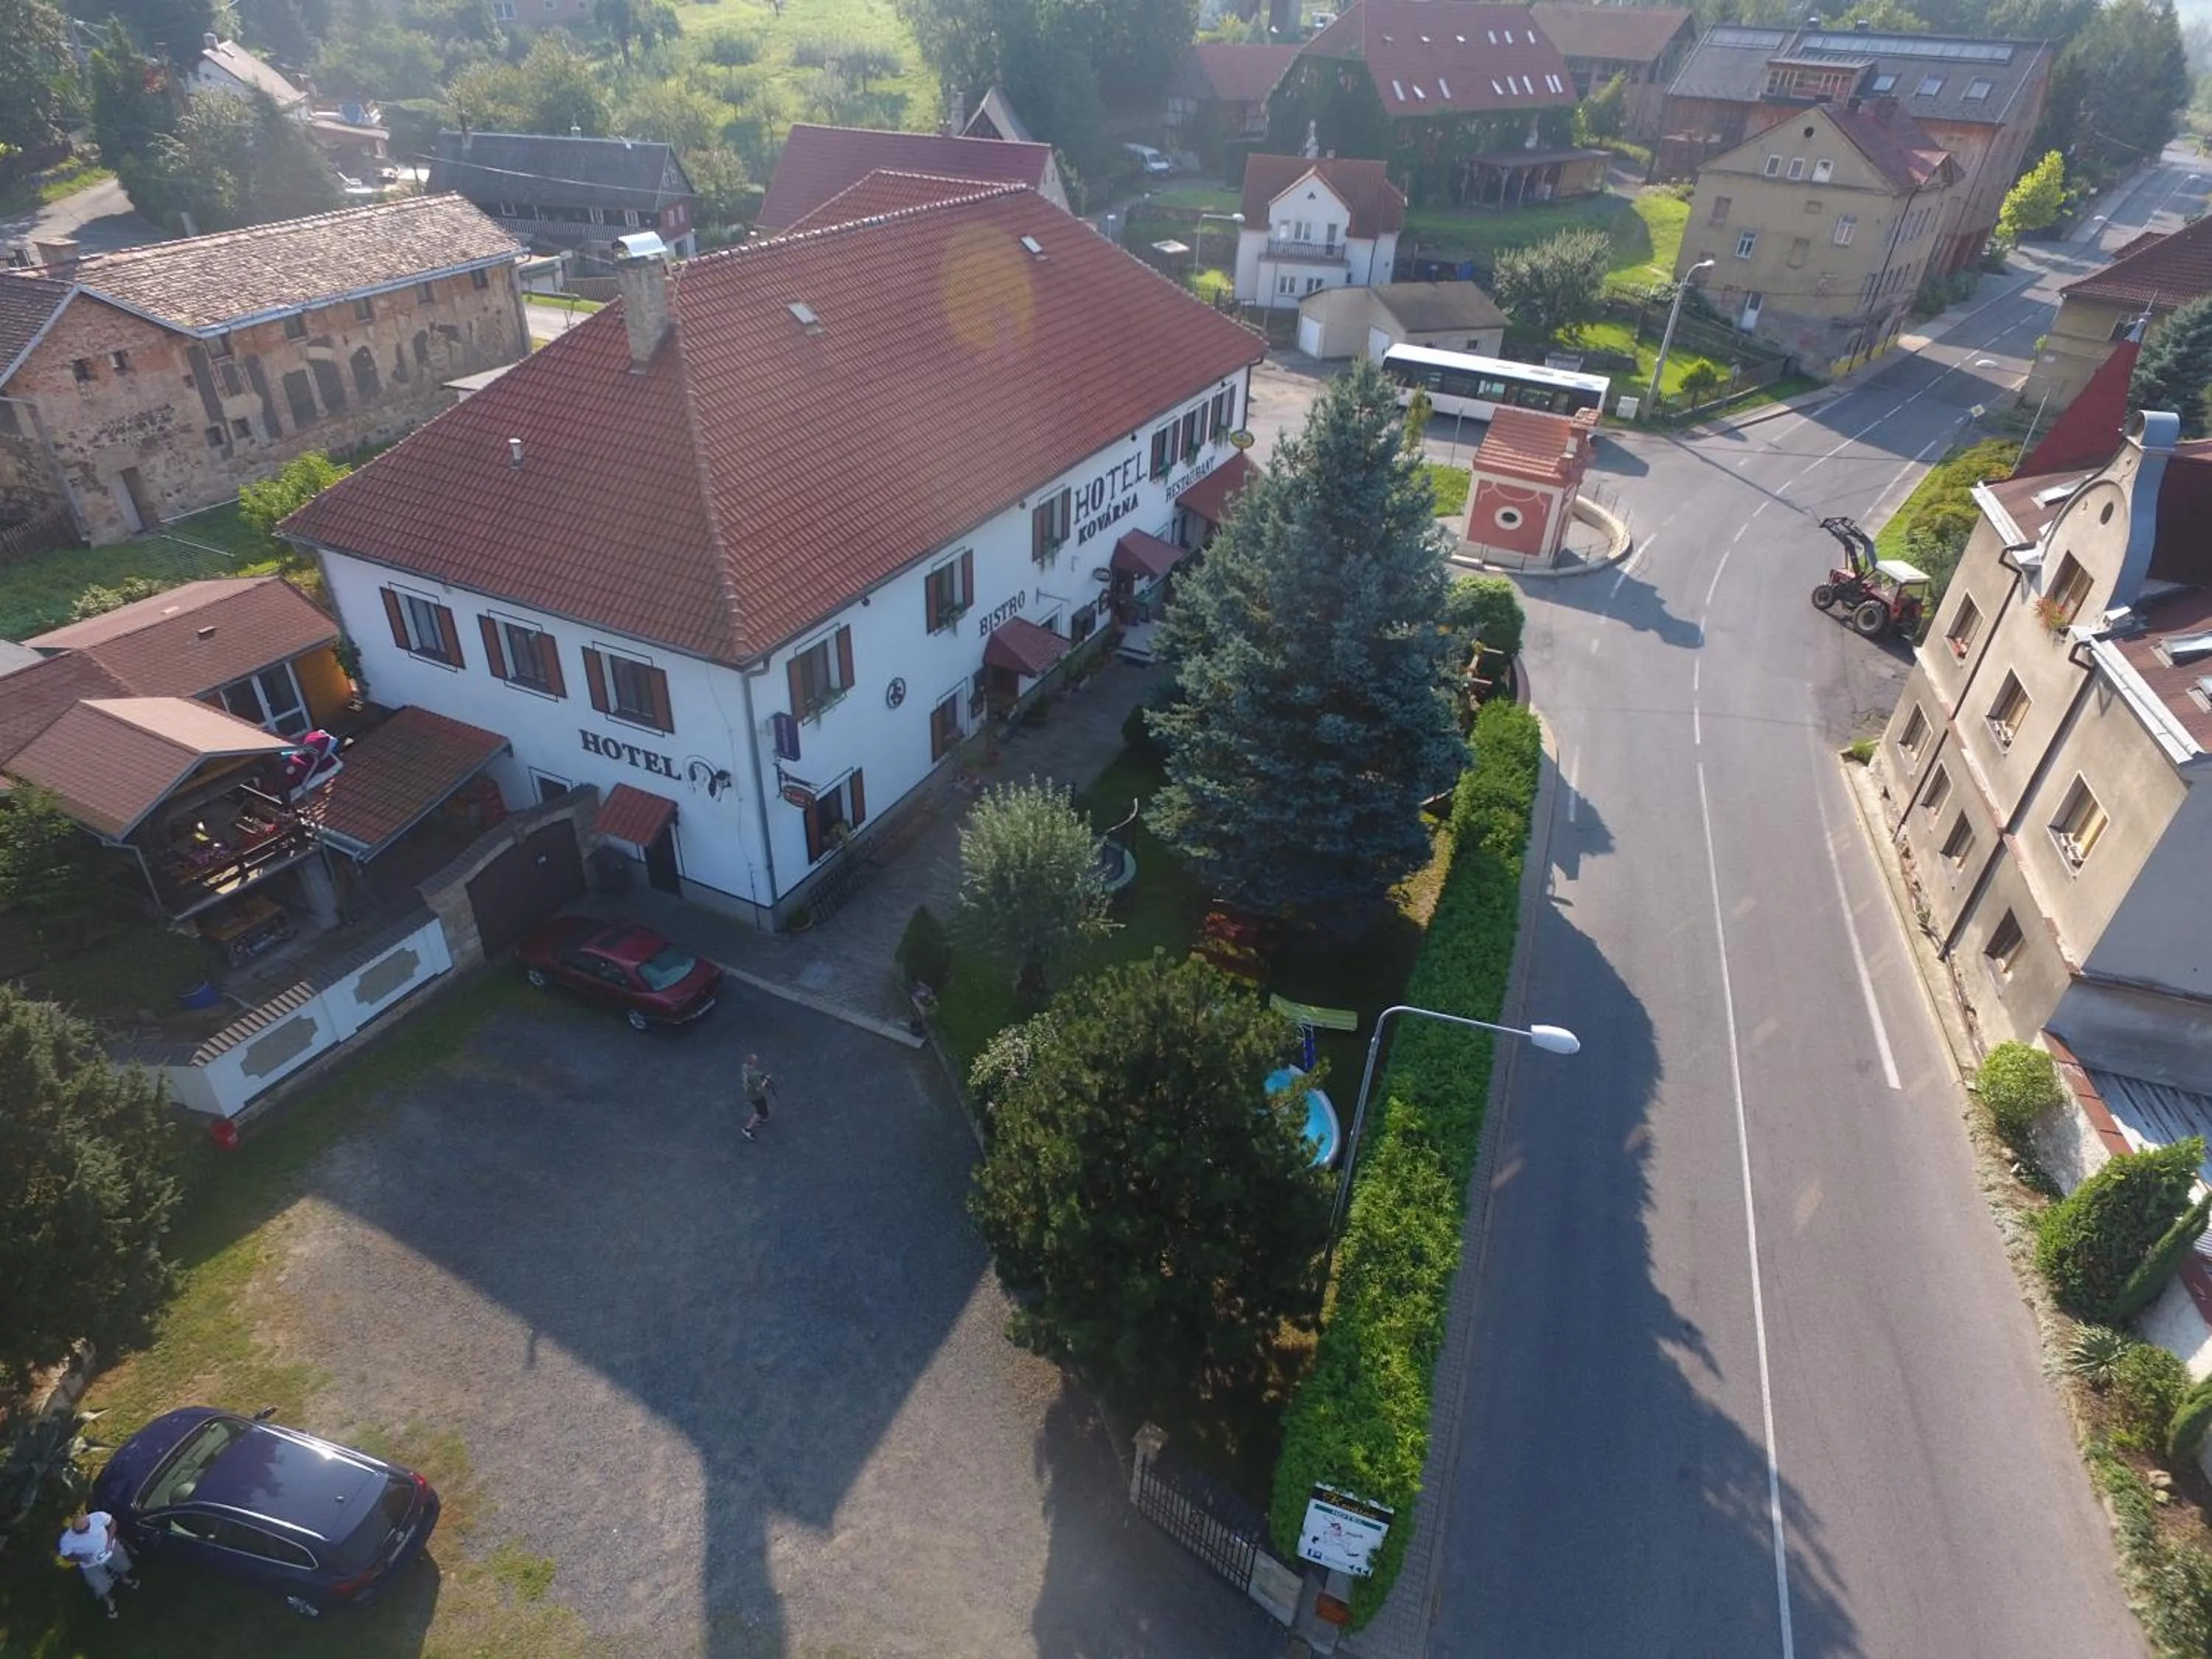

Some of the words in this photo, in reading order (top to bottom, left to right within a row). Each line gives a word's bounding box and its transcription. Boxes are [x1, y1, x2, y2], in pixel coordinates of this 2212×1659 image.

[1074, 451, 1147, 524] HOTEL
[1078, 493, 1139, 546] KOVÁRNA
[978, 590, 1026, 638] BISTRO
[578, 728, 682, 780] HOTEL
